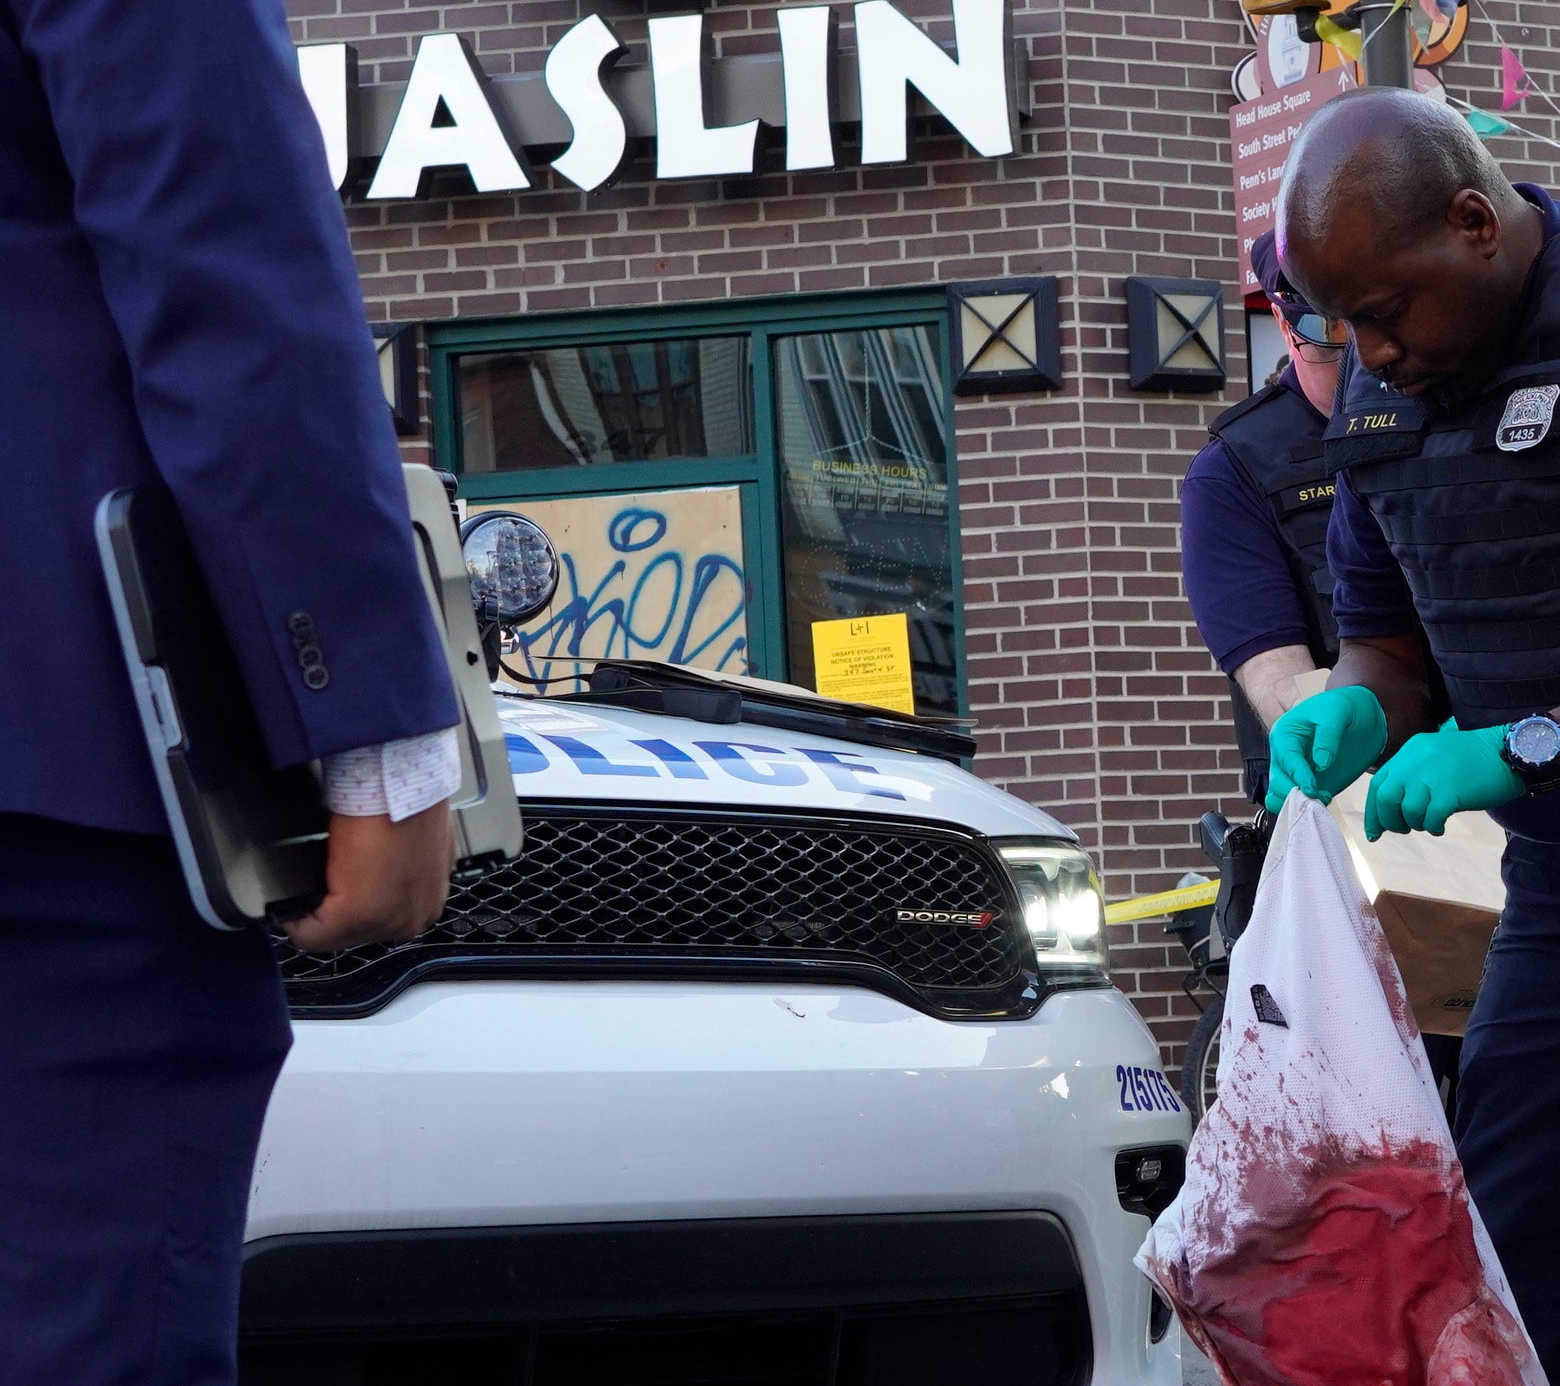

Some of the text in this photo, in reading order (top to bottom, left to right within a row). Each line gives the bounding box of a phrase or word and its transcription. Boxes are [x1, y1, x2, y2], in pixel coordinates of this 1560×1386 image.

[1235, 89, 1311, 128] Head House Square
[1238, 135, 1262, 159] South
[1262, 128, 1287, 151] Street
[1239, 167, 1266, 191] Penn's
[1241, 201, 1271, 223] Society
[1346, 412, 1397, 434] T. TULL
[1508, 427, 1536, 442] 1435
[812, 459, 928, 481] BUSINESS HOURS
[1299, 484, 1336, 502] STAR
[830, 657, 852, 665] NOTICE
[863, 653, 894, 662] VIOLATION
[831, 646, 892, 658] UNSAFE STRUCTURE
[505, 731, 908, 802] OLICE
[896, 909, 984, 925] DODGE
[1116, 1064, 1181, 1114] 215175
